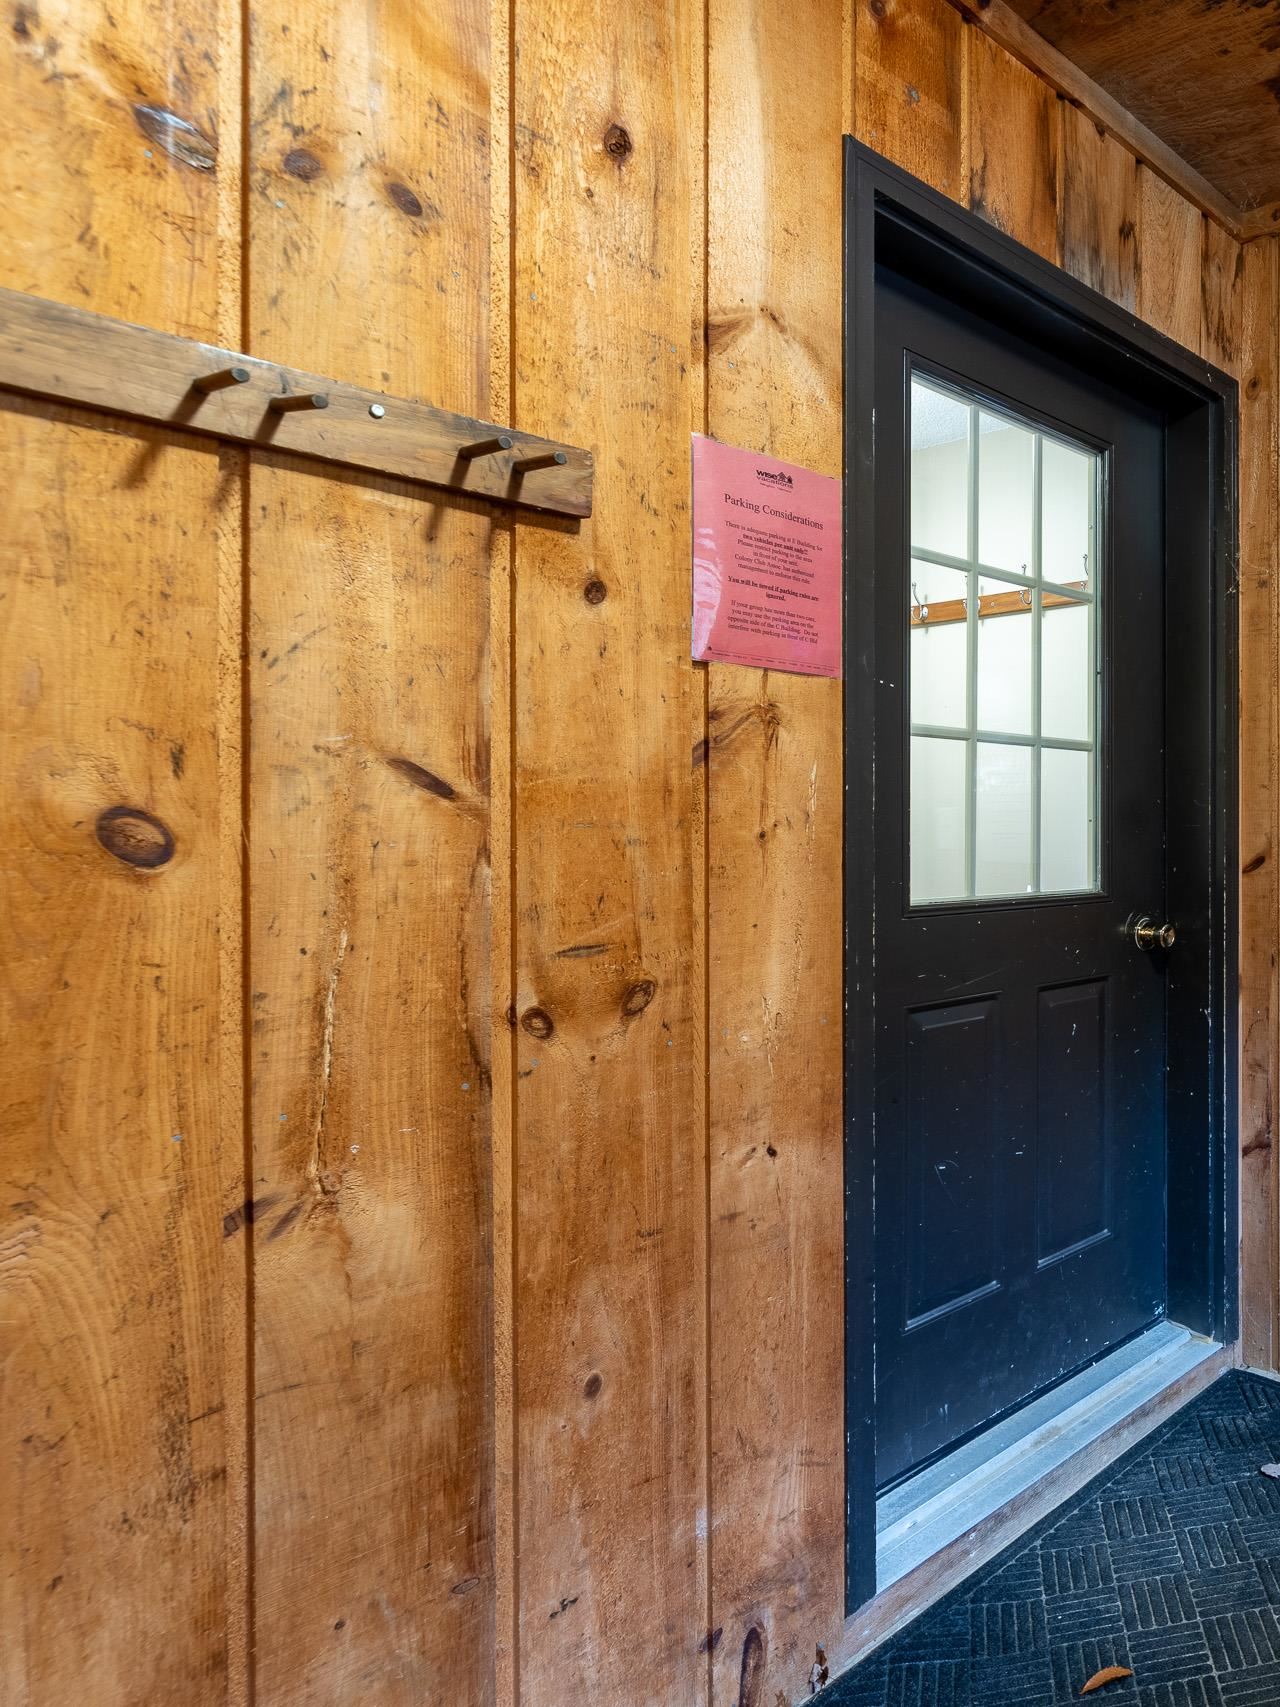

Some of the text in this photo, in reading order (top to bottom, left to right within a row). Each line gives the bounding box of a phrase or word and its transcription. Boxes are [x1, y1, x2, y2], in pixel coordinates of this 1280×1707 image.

[724, 493, 824, 530] Parking Considerations
[726, 521, 740, 529] There
[769, 533, 786, 542] parking
[797, 540, 815, 550] Building
[754, 537, 773, 546] vehicles
[738, 539, 753, 547] Please
[772, 549, 788, 558] parking
[735, 554, 753, 563] Colony
[738, 563, 768, 574] management
[728, 575, 739, 583] You
[780, 588, 798, 597] parking
[728, 616, 748, 624] opposite
[772, 617, 789, 625] parking
[762, 630, 780, 638] parking
